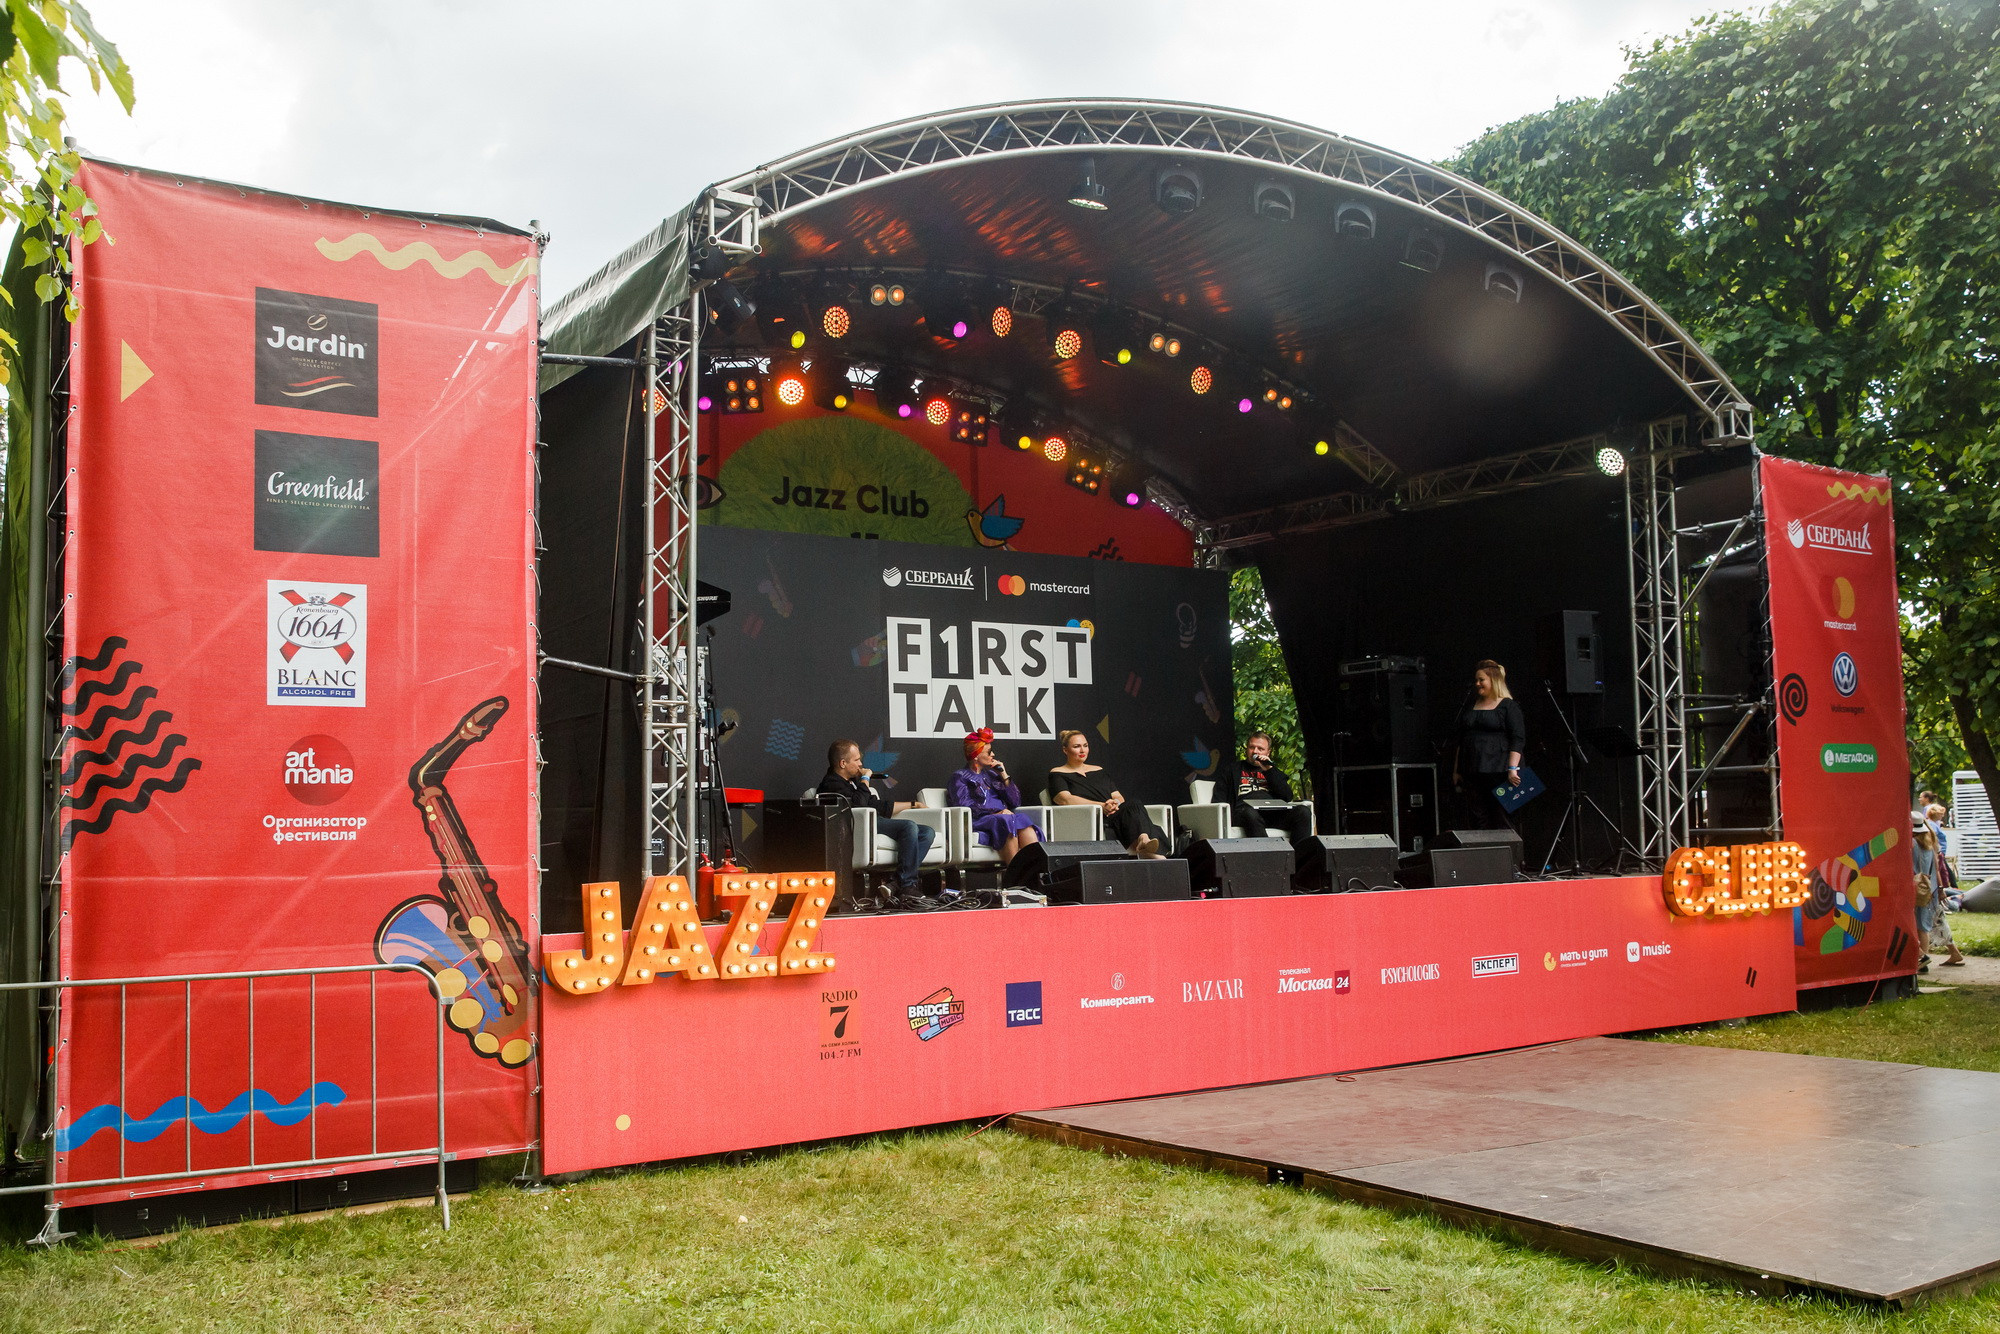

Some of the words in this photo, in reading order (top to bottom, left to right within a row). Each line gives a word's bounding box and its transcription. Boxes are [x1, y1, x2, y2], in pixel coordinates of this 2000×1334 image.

[266, 325, 365, 359] Jardin
[267, 471, 366, 502] Greenfield
[771, 475, 847, 511] Jazz
[856, 484, 930, 519] Club
[1029, 581, 1091, 595] mastercard
[296, 606, 339, 615] Kronenbourg
[288, 614, 347, 640] 1664
[897, 623, 1088, 678] F1RST
[278, 669, 356, 687] BLANC
[282, 688, 327, 696] ALCOHOL
[893, 683, 1053, 734] TALK
[285, 747, 315, 768] art
[285, 764, 354, 784] mania
[262, 815, 367, 830] Организатор
[273, 829, 357, 845] фестиваля
[545, 871, 836, 995] JAZZ
[1642, 941, 1671, 956] music
[1475, 957, 1516, 970] ЭКСПЕРТ
[1183, 978, 1244, 1003] BAZAAR
[1277, 977, 1333, 994] Москва
[1336, 976, 1350, 989] 24
[821, 989, 858, 1003] RADIO
[1080, 995, 1155, 1009] Коммерсантъ
[951, 1003, 962, 1013] TV
[830, 1005, 850, 1039] 7
[912, 1017, 928, 1028] THIS
[820, 1049, 845, 1060] 104.7
[847, 1048, 861, 1057] FM
